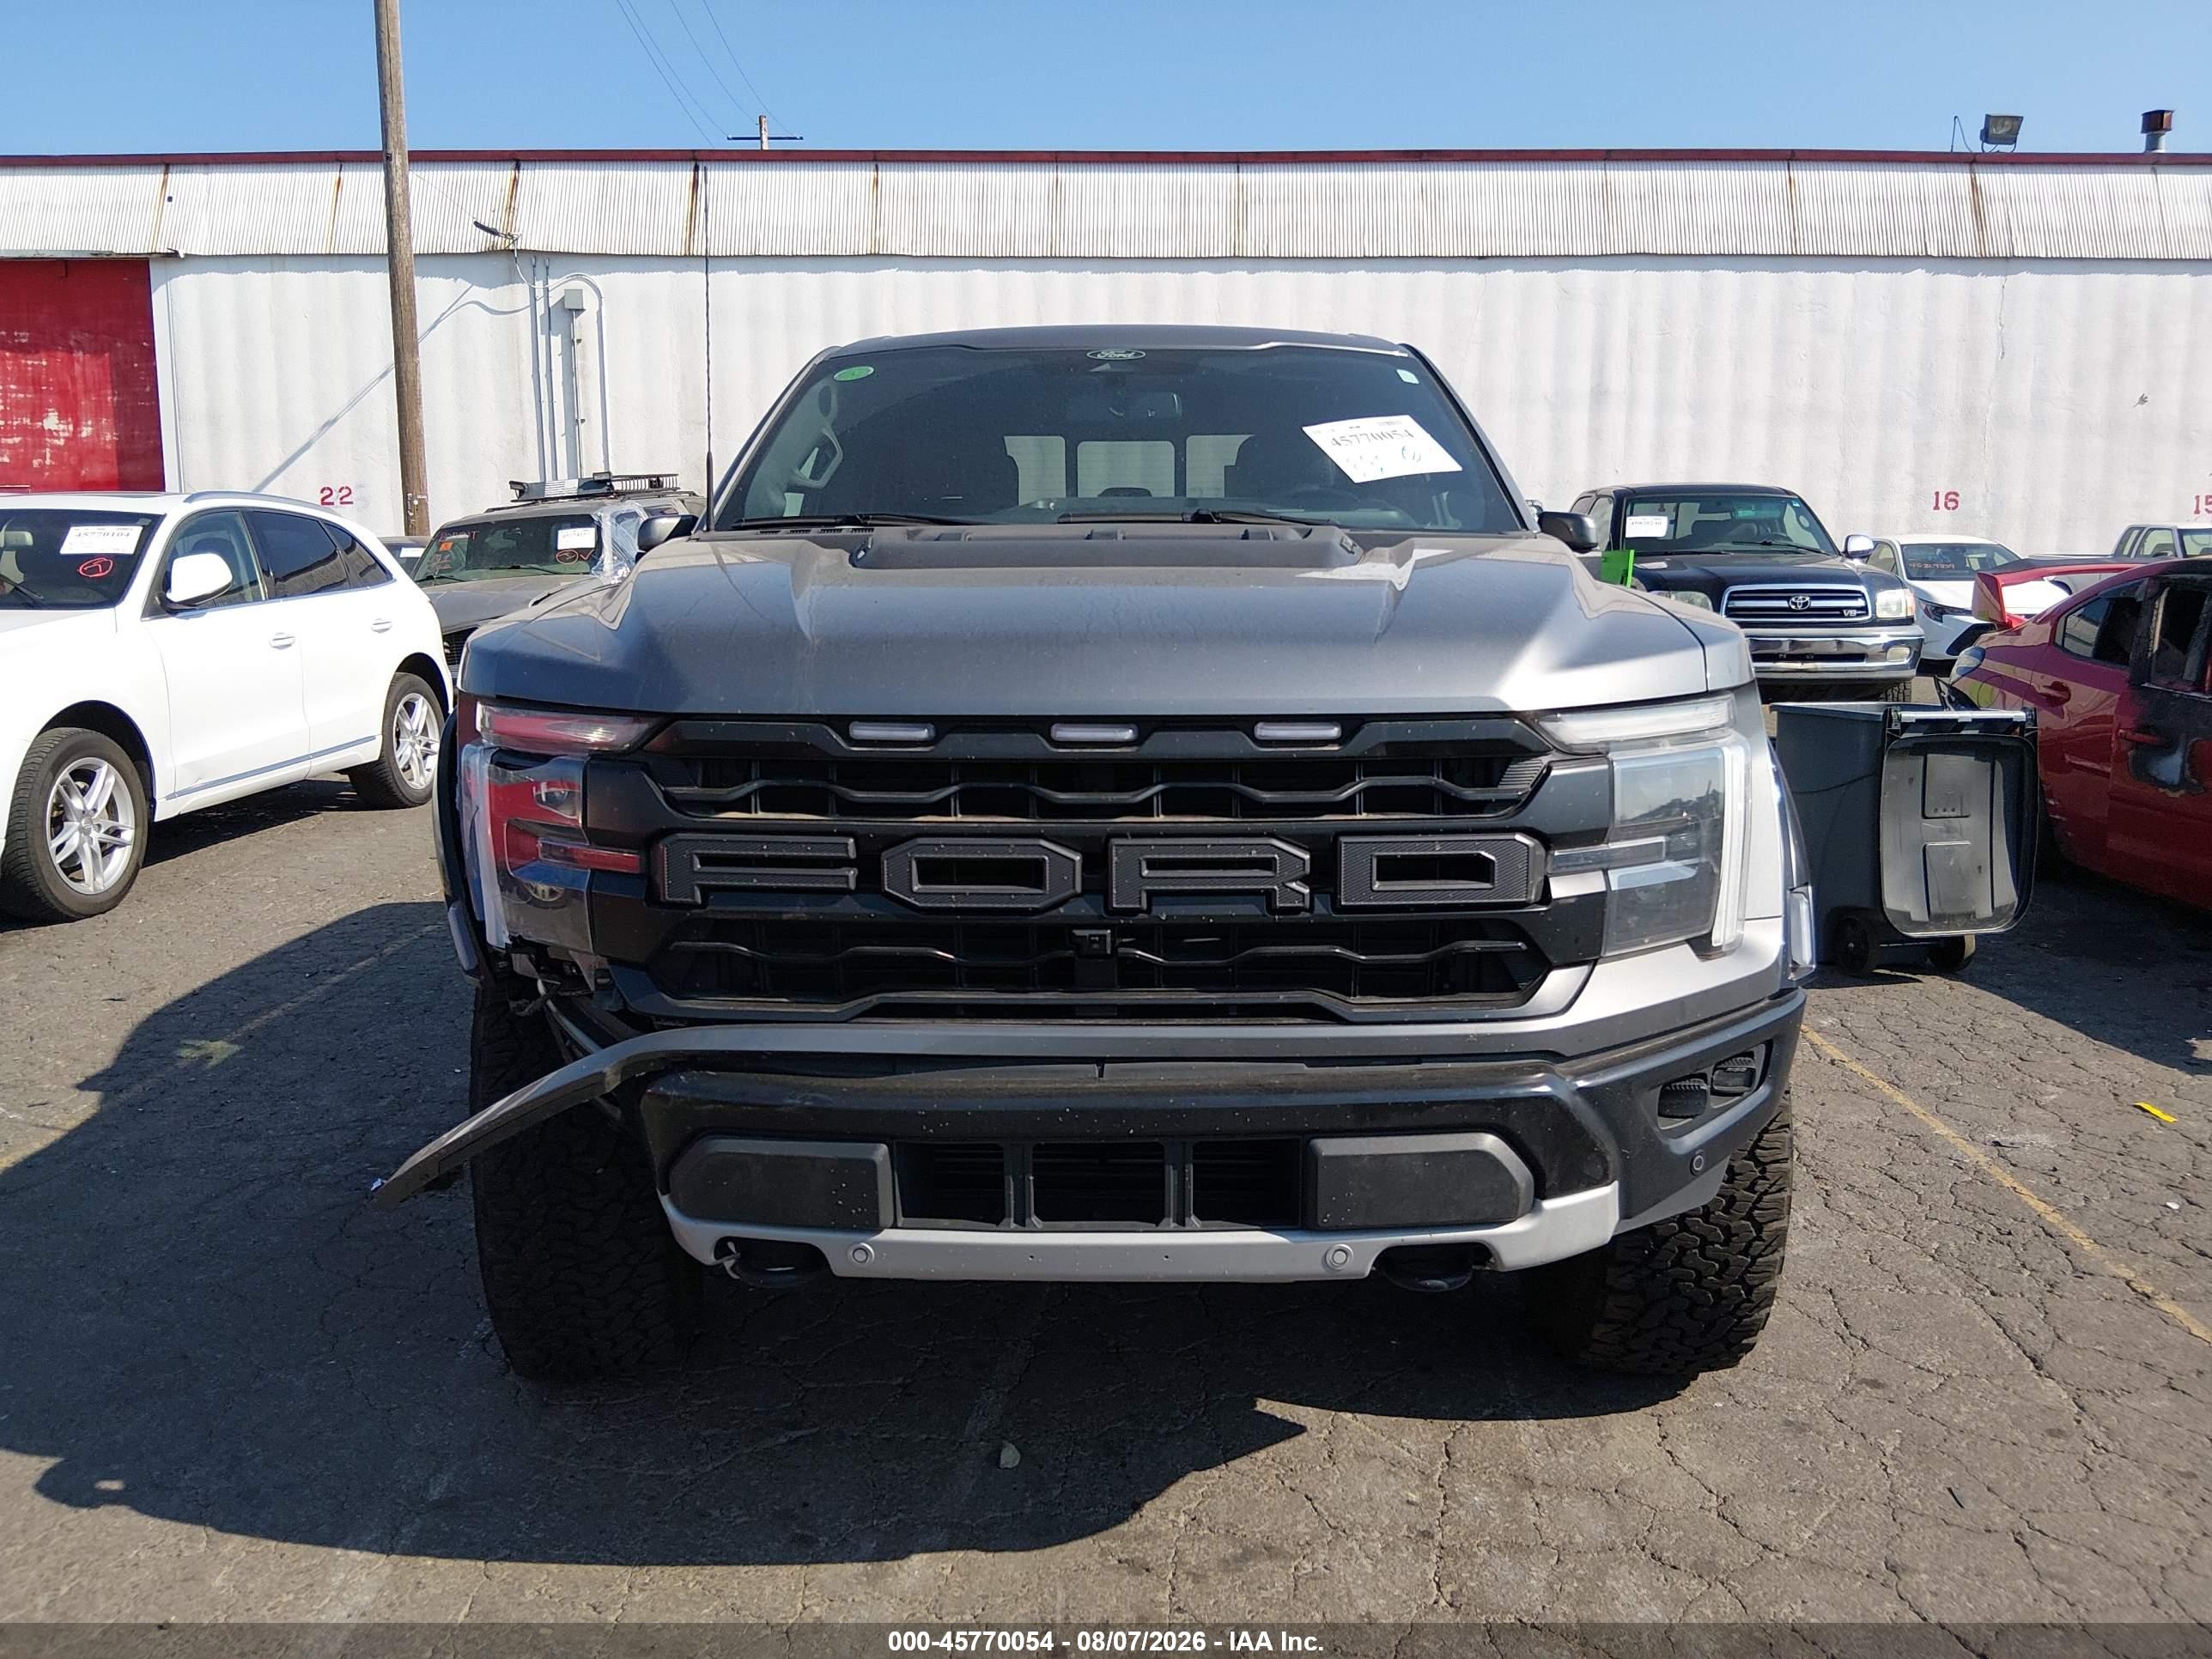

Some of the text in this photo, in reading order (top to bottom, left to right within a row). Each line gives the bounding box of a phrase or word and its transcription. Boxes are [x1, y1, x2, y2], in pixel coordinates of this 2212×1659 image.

[1096, 349, 1137, 359] Ford
[320, 486, 354, 506] 22
[1933, 491, 1960, 511] 16
[658, 833, 1545, 915] FORD
